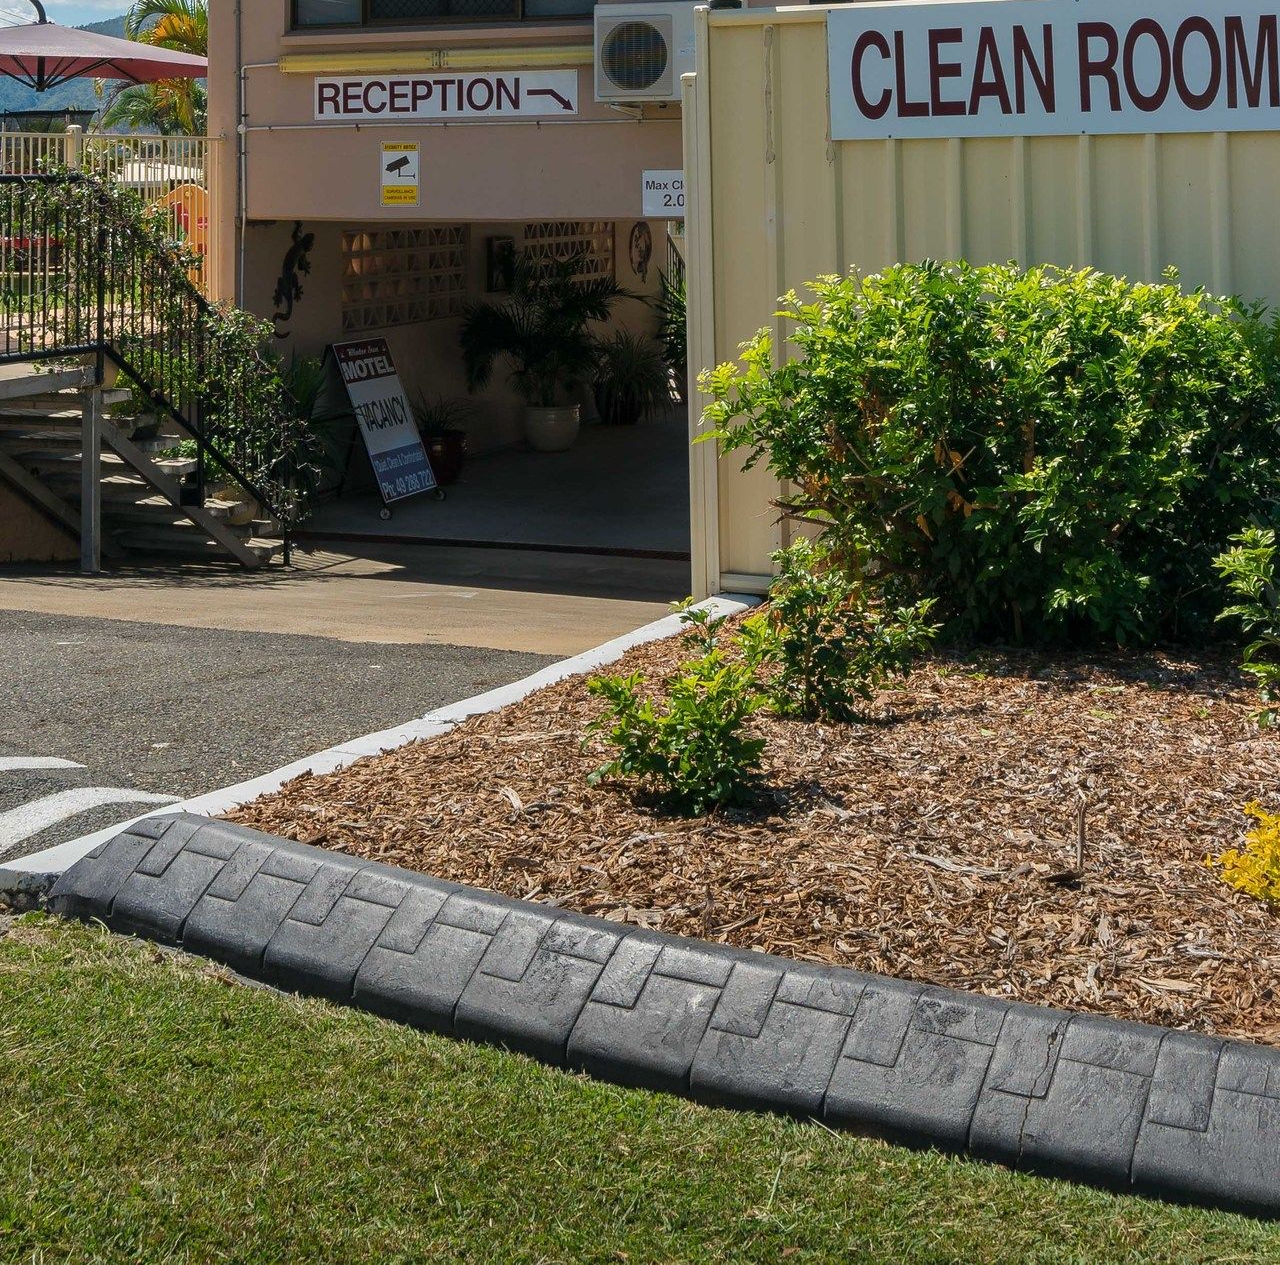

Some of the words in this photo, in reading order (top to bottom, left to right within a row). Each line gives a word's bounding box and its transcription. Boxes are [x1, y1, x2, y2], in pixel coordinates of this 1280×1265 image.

[851, 23, 1056, 120] CLEAN
[317, 77, 520, 115] RECEPTION
[645, 180, 669, 190] Max
[671, 180, 684, 190] Cl
[663, 193, 685, 207] 2.0
[341, 355, 395, 381] MOTEL
[358, 395, 409, 432] VACANCY
